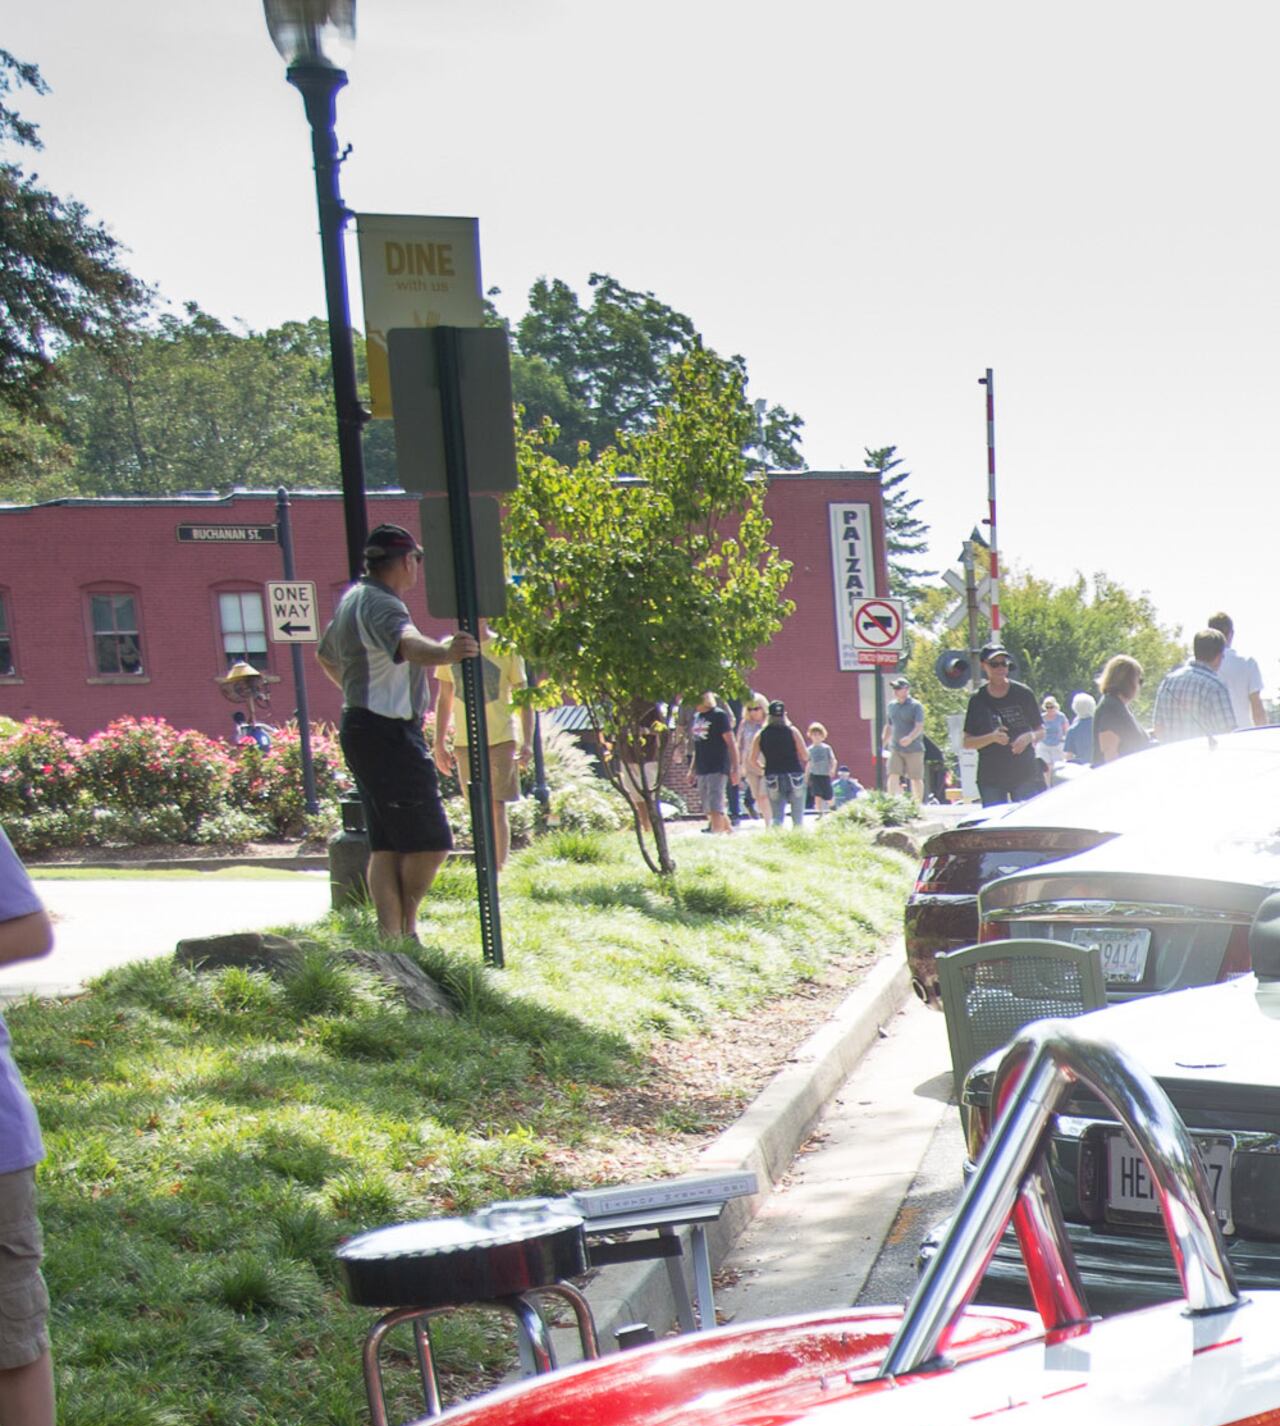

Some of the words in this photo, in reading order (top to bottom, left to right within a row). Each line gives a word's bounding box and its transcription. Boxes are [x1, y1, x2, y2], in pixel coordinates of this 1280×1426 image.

[384, 241, 456, 276] DINE
[192, 528, 246, 540] BUCHANAN
[248, 530, 262, 540] ST.
[842, 510, 864, 618] PAIZAN
[273, 587, 308, 601] ONE
[274, 603, 310, 618] WAY
